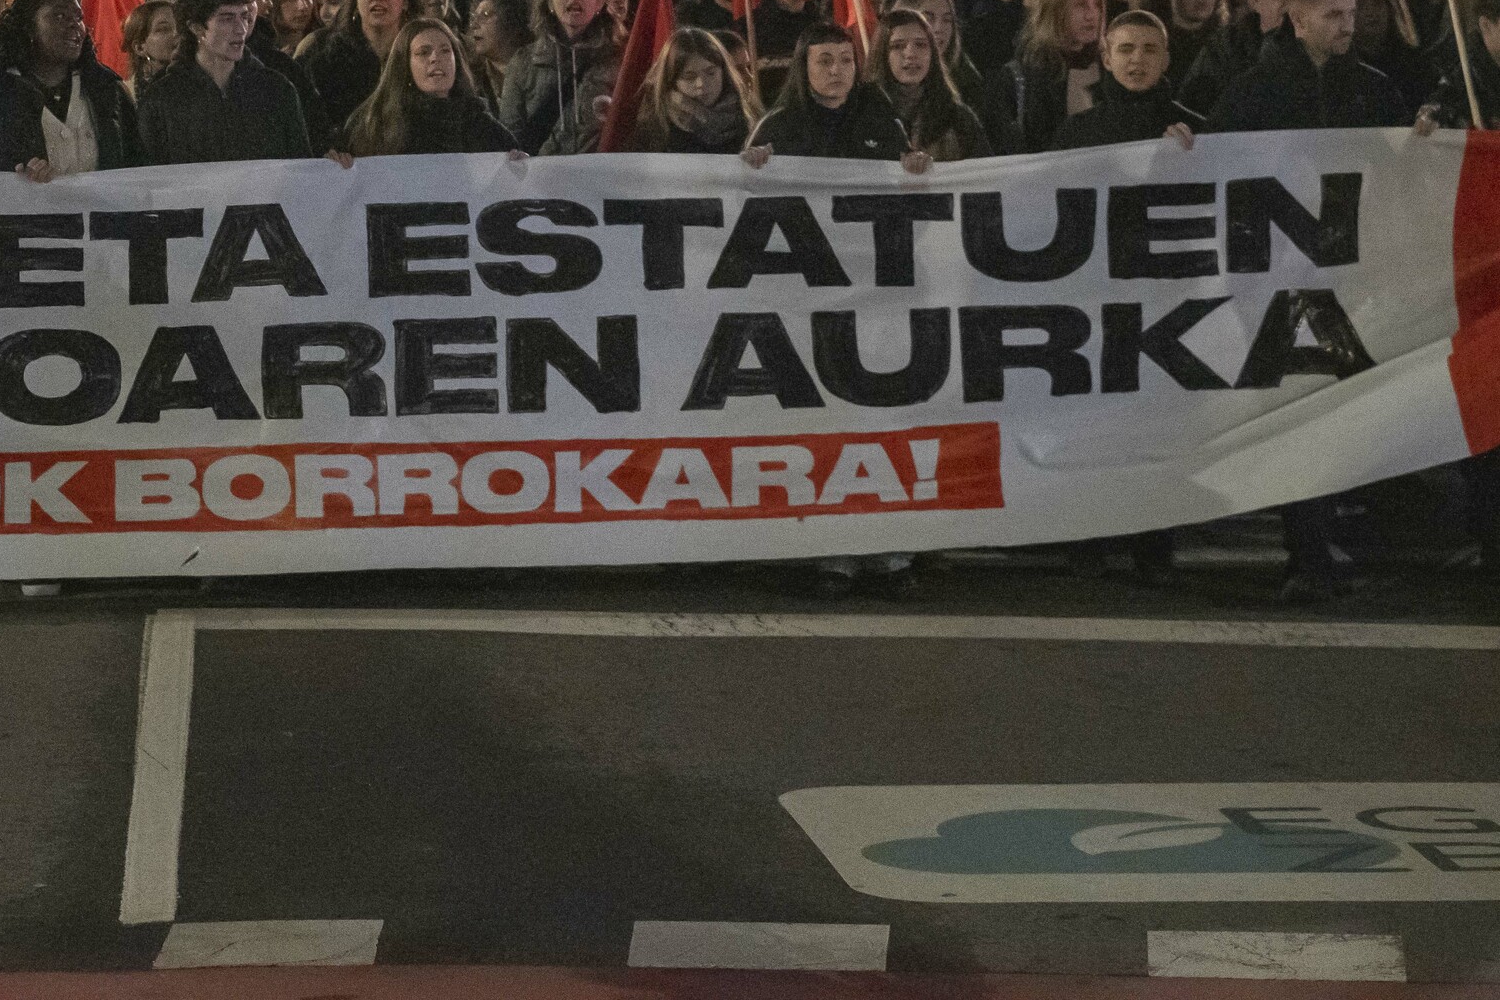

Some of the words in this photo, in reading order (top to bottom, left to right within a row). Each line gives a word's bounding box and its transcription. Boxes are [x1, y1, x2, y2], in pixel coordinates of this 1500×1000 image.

[366, 172, 1363, 298] ESTATUEN
[680, 288, 1380, 412] AURKA
[115, 438, 941, 523] BORROKARA!
